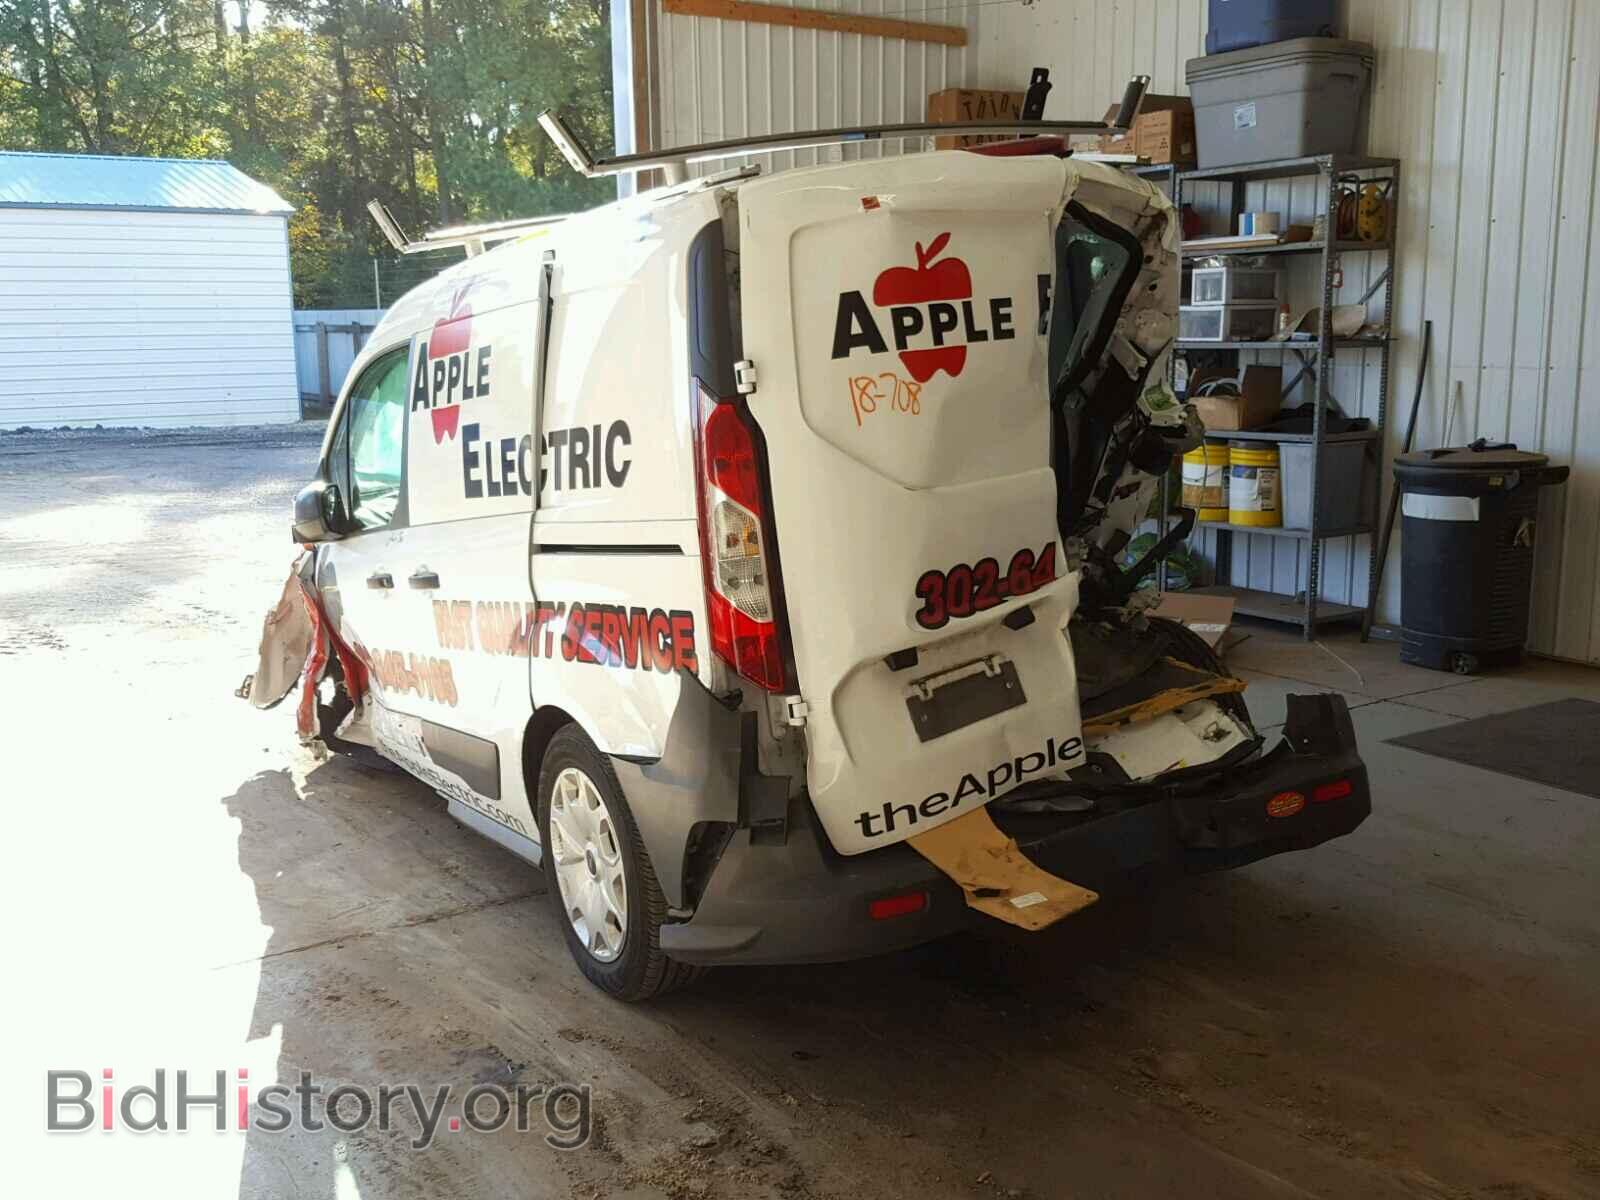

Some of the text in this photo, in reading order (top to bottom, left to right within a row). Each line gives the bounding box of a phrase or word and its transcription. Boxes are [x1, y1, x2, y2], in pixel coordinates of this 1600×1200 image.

[832, 290, 1016, 361] APPLE
[411, 342, 492, 412] APPLE
[848, 372, 922, 427] 18-708
[461, 419, 632, 499] ELECTRIC
[560, 601, 699, 678] SERVICE
[854, 735, 1083, 838] theApple
